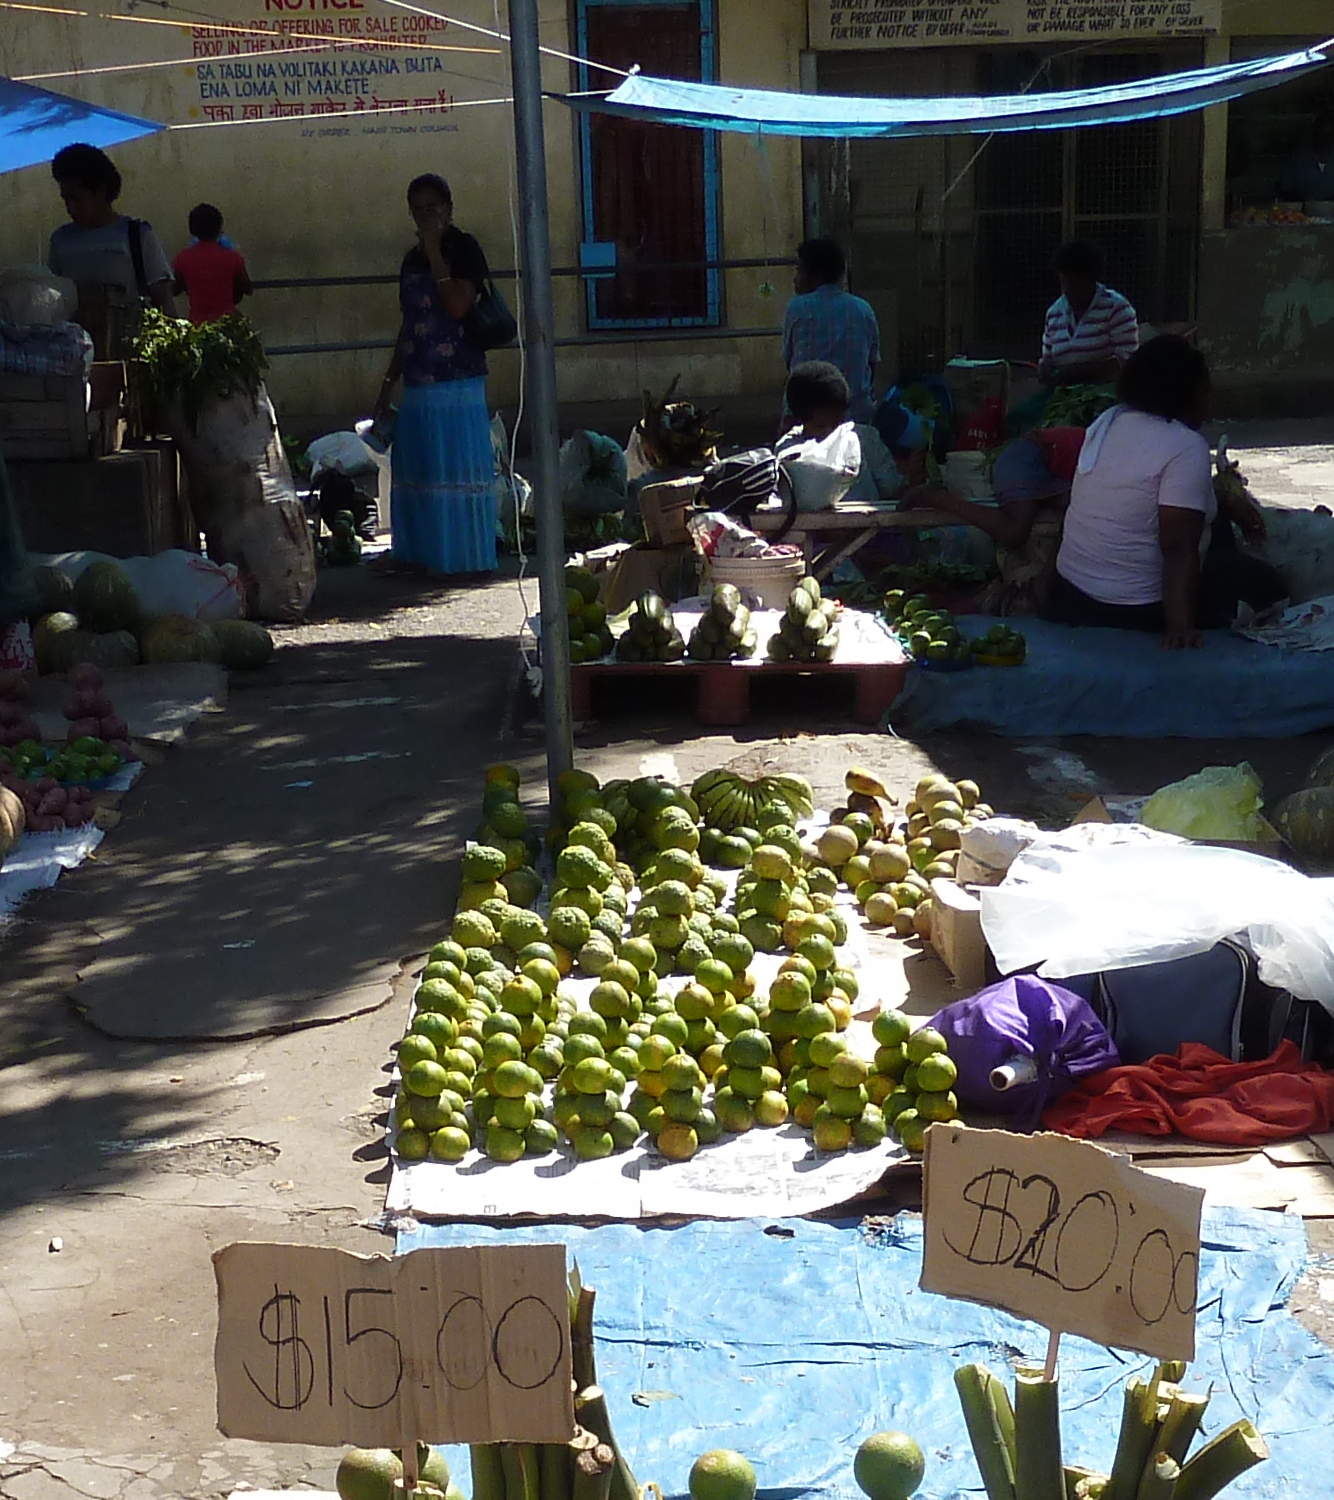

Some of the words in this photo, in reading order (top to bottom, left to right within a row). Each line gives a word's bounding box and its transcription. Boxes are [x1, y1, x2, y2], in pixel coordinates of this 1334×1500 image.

[961, 7, 988, 20] ANY
[1050, 7, 1062, 19] BE
[1130, 4, 1145, 15] FOR
[1148, 4, 1168, 15] ANY
[192, 20, 246, 39] SELLING
[272, 18, 334, 35] OFFERING
[339, 17, 361, 34] FOR
[365, 16, 398, 33] SALE
[877, 24, 919, 38] NOTICE
[1043, 19, 1085, 32] DAMAGE
[193, 40, 223, 57] FOOD
[228, 40, 240, 55] IN
[243, 38, 267, 54] THE
[197, 63, 215, 80] SA
[219, 62, 253, 79] TABU
[257, 62, 276, 78] NA
[279, 58, 337, 77] VOLITAKI
[341, 57, 401, 75] KAKANA
[405, 56, 443, 73] BUTA
[200, 81, 230, 99] ENA
[235, 80, 279, 97] LOMA
[285, 78, 300, 95] NI
